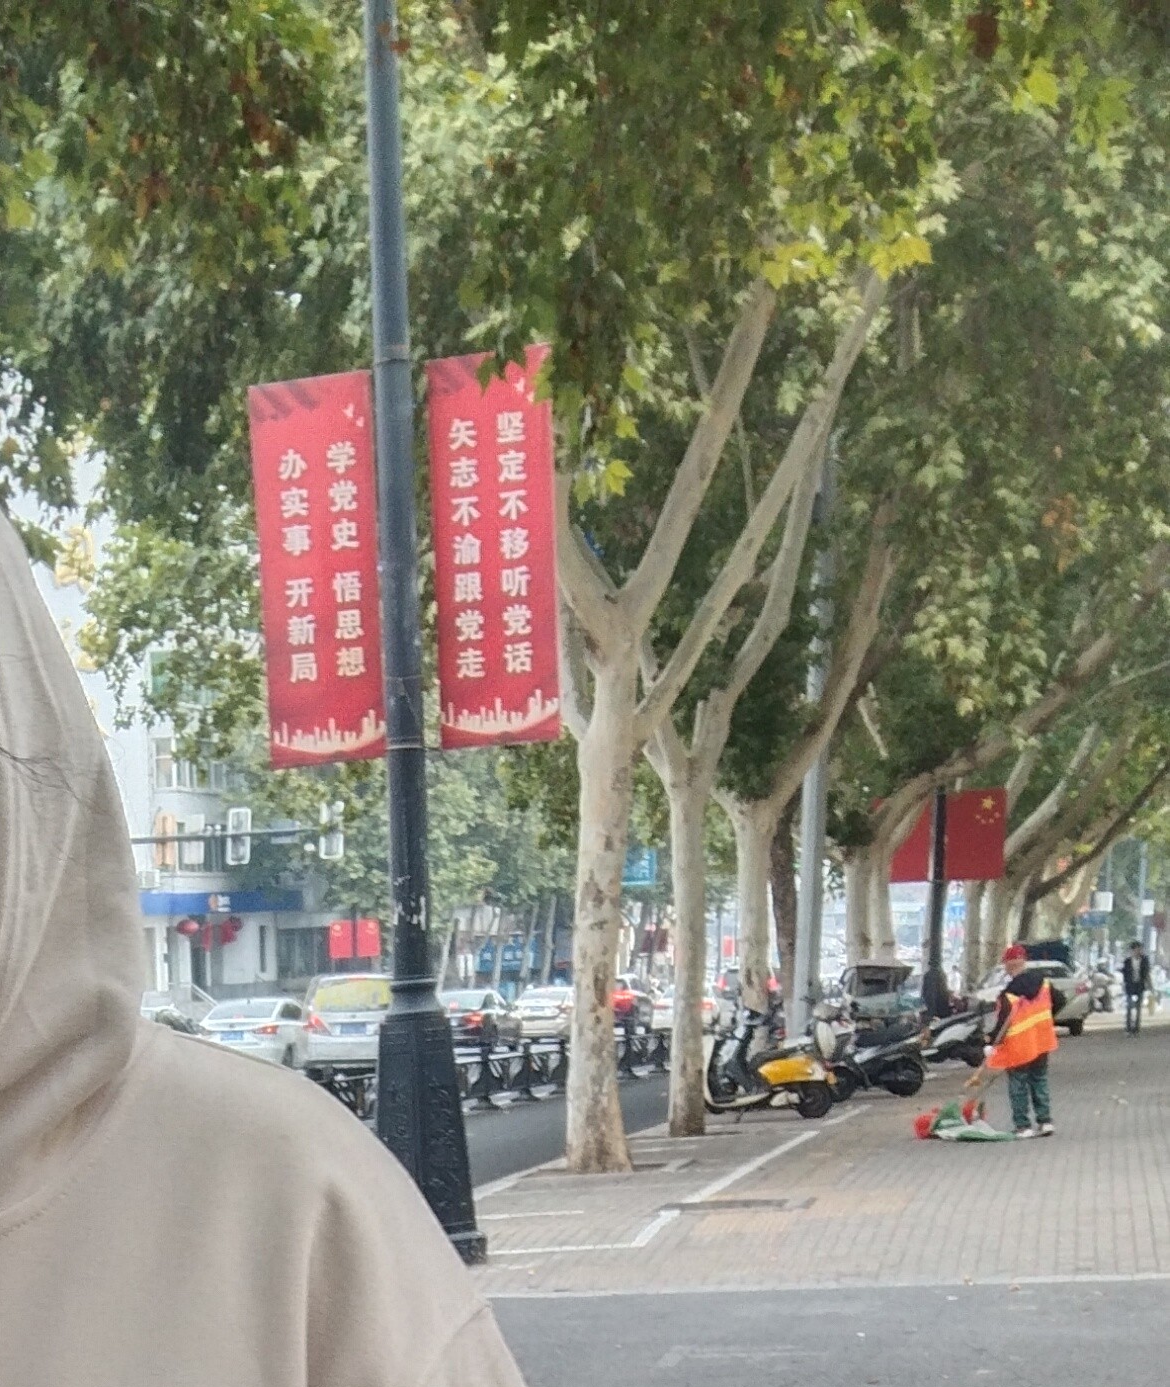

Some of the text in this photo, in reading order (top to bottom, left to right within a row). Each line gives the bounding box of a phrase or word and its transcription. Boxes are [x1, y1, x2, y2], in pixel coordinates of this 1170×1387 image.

[277, 448, 318, 684] 办实事 开新局
[325, 440, 366, 677] 学党史 悟思想
[447, 418, 486, 679] 矢志不渝跟党走
[495, 410, 534, 674] 坚定不移听党话
